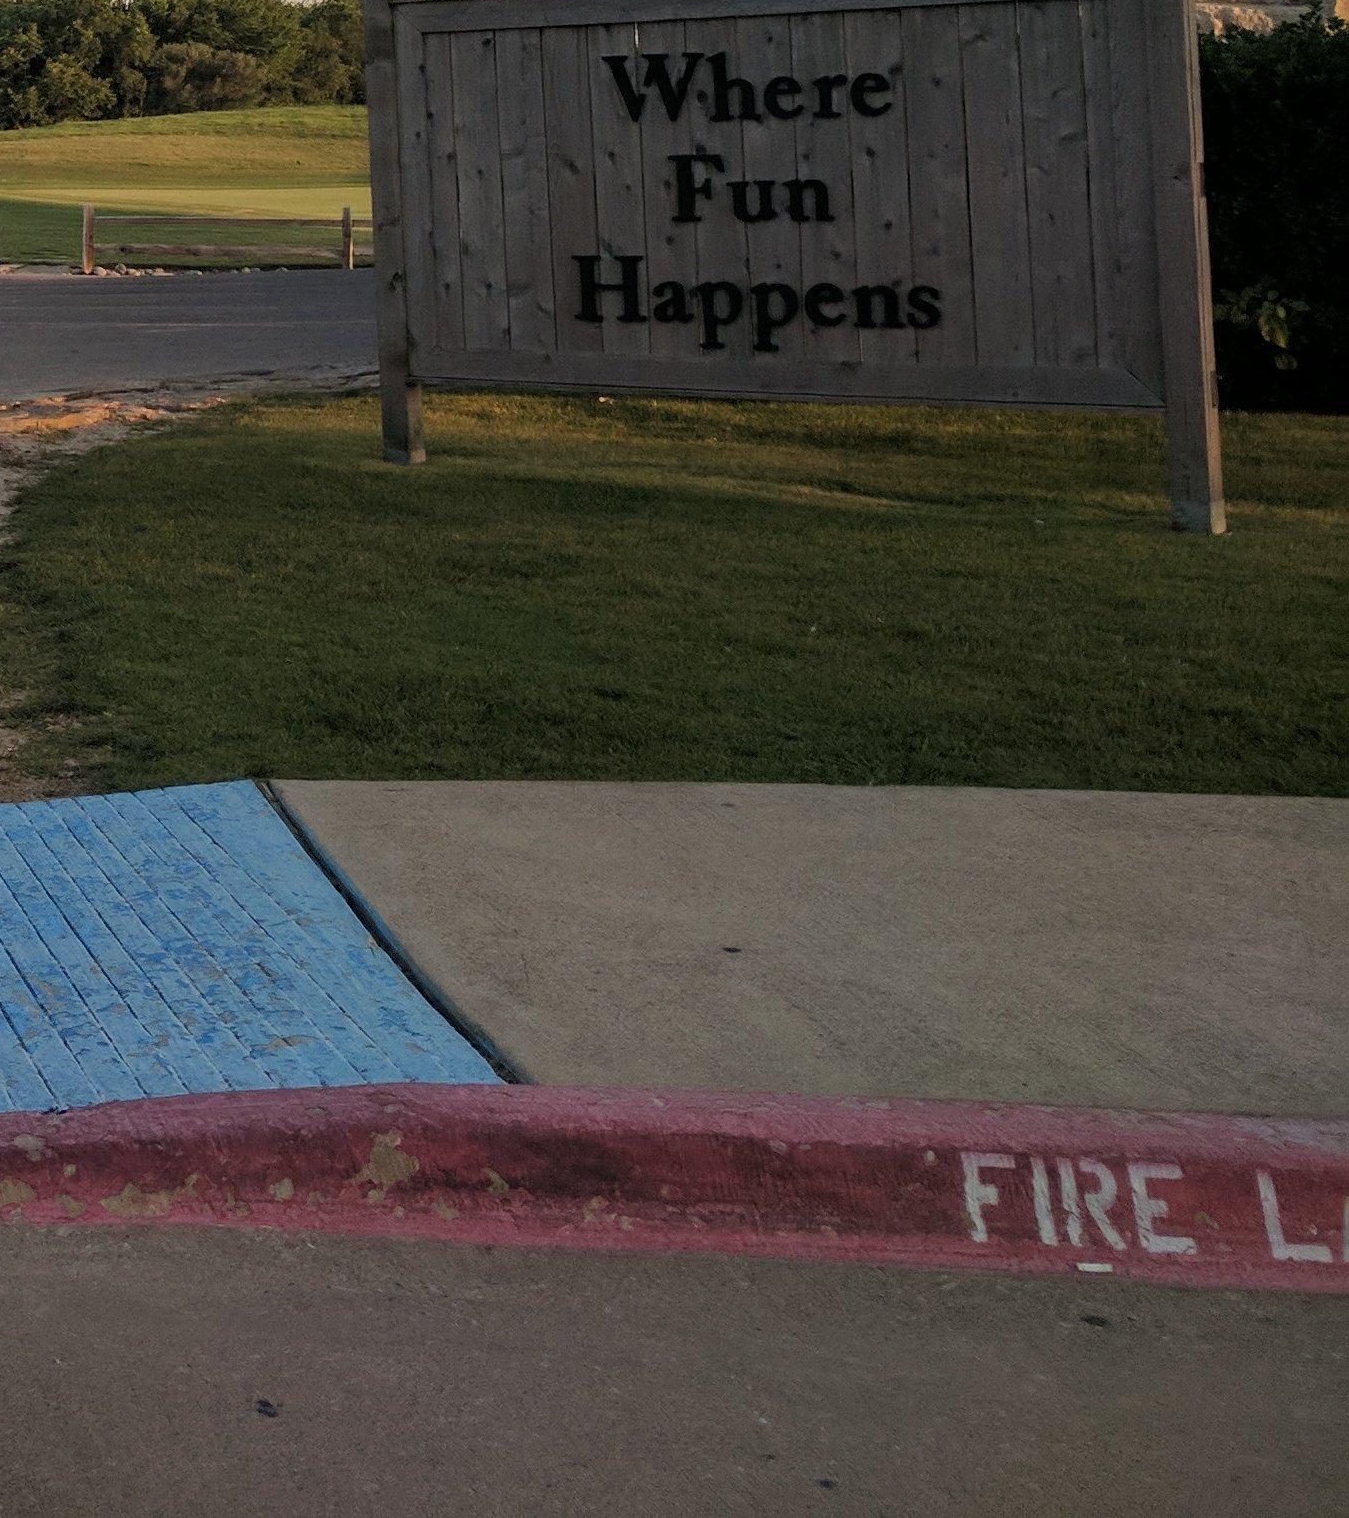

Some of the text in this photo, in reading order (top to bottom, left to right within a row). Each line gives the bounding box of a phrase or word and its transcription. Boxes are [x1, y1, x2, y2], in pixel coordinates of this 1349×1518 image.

[602, 52, 893, 123] Where
[668, 154, 836, 223] Fun
[571, 255, 942, 352] Happens
[961, 1152, 1349, 1263] FIRE L
